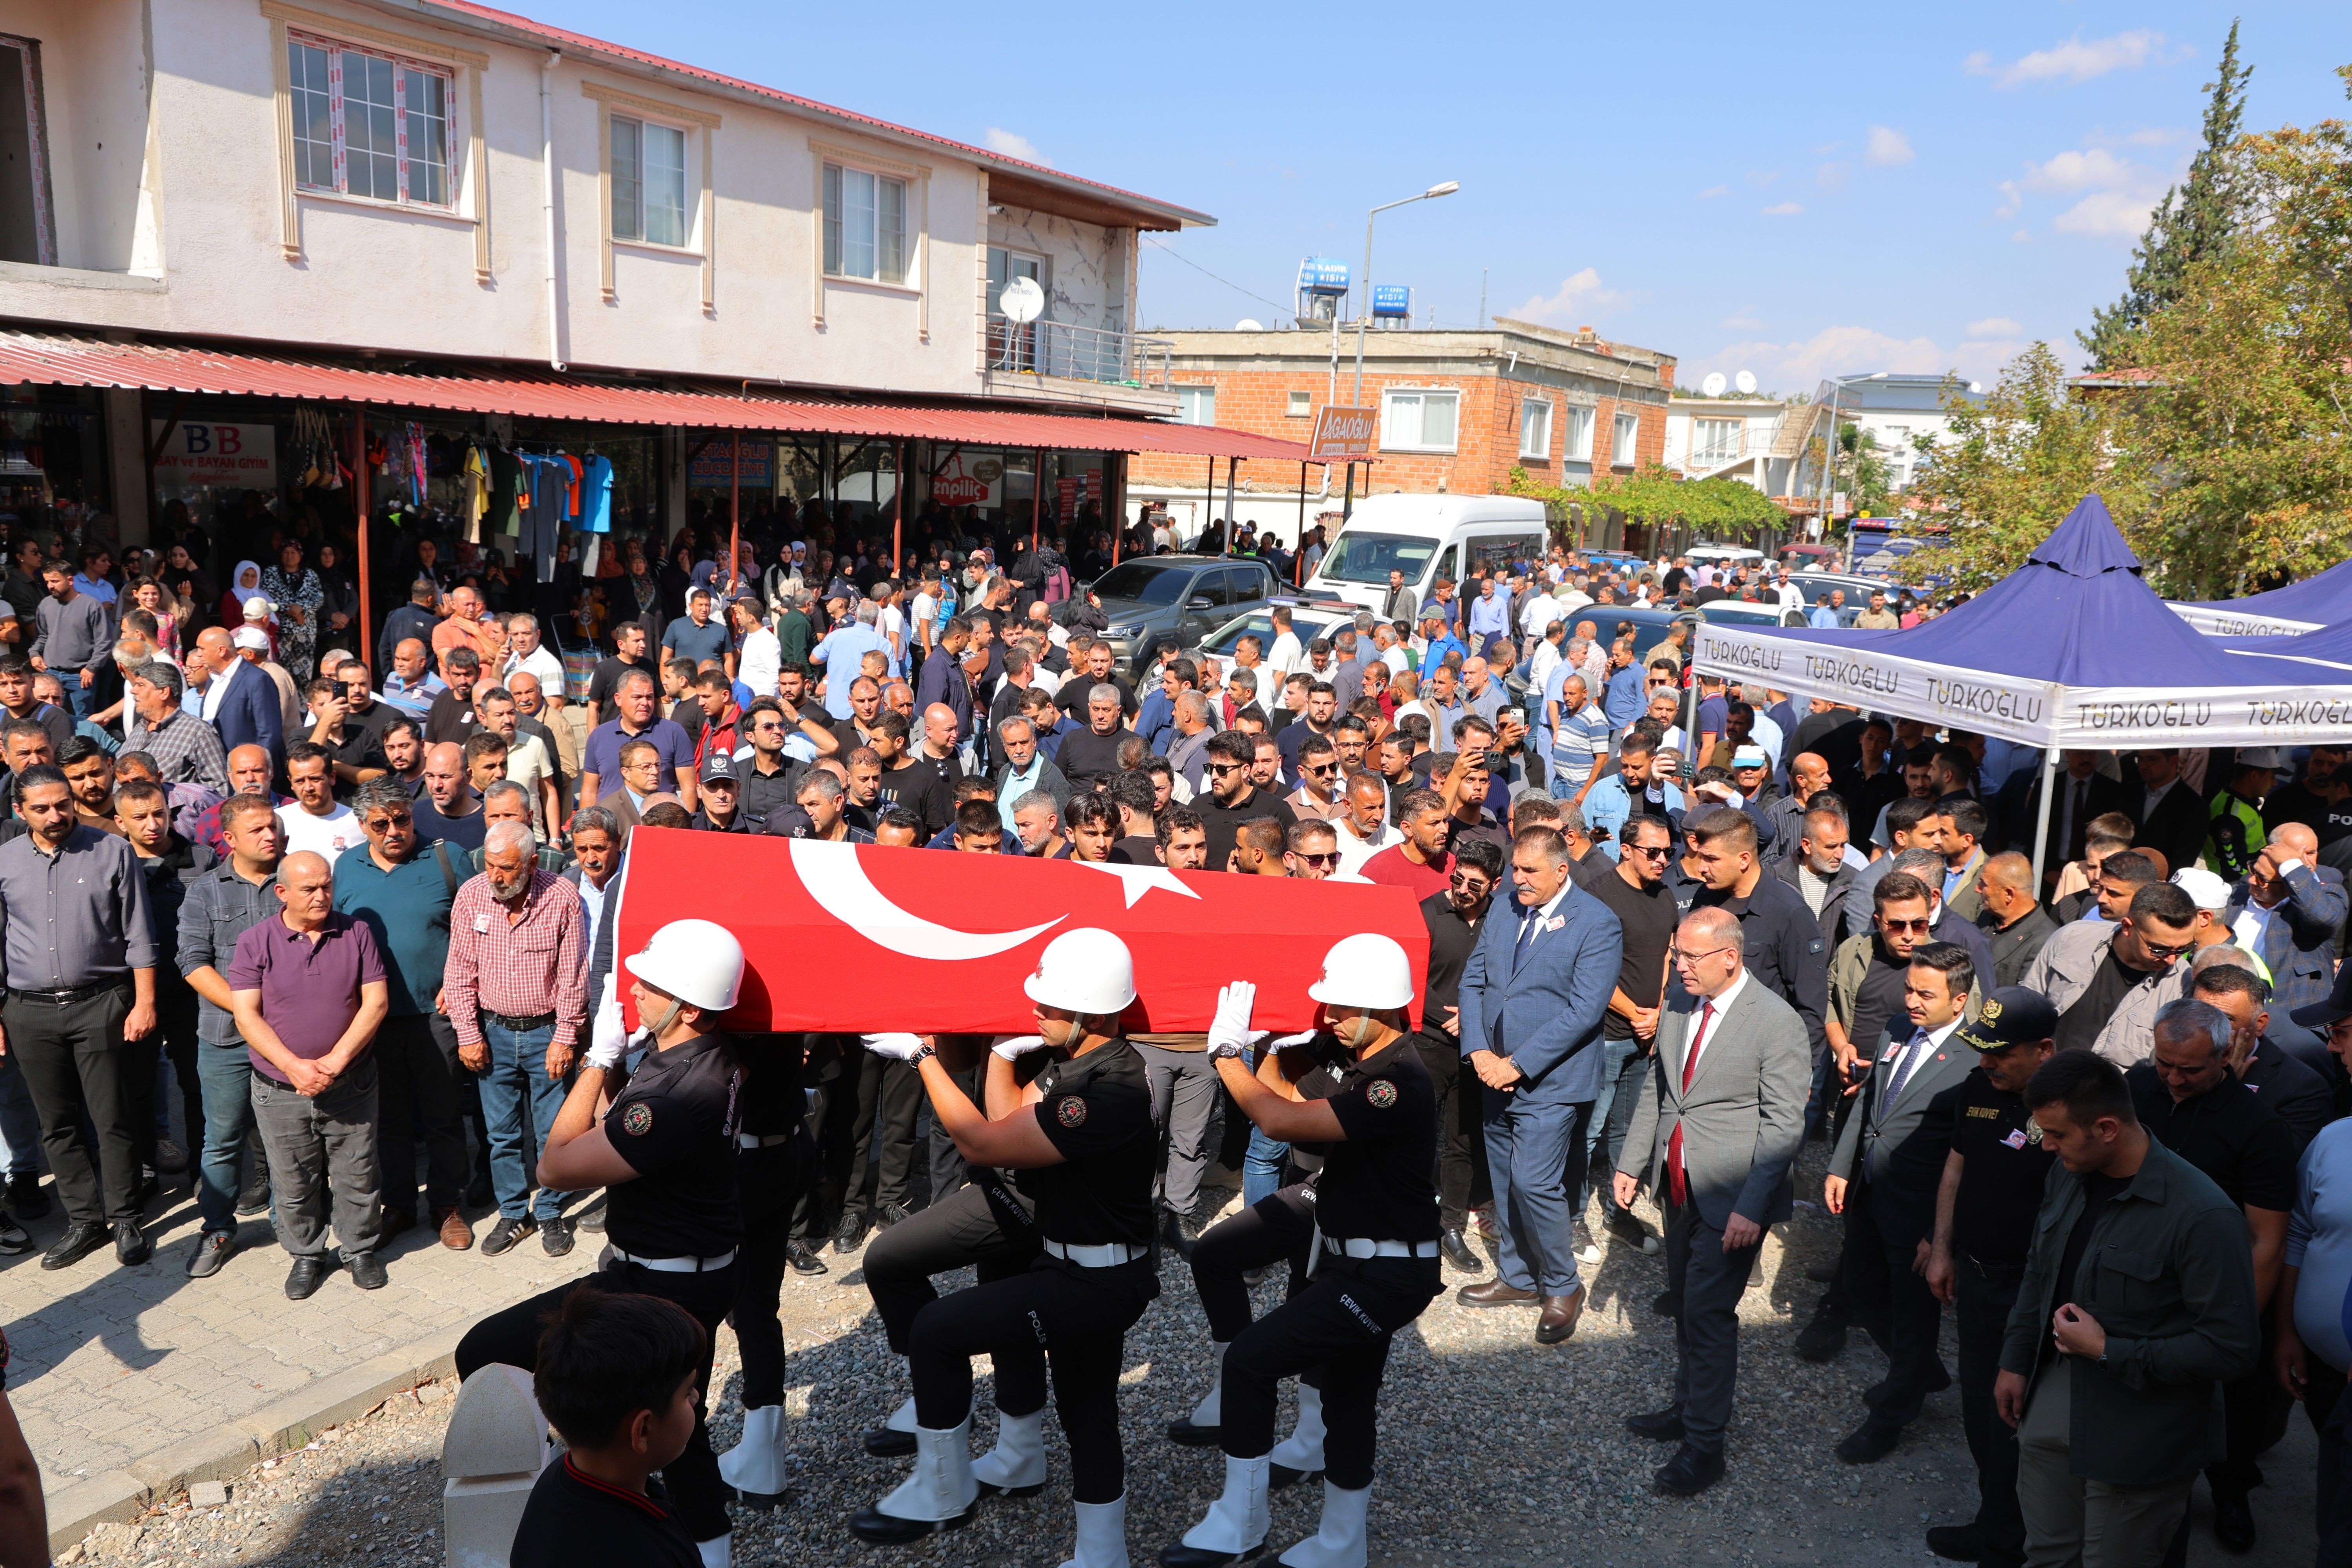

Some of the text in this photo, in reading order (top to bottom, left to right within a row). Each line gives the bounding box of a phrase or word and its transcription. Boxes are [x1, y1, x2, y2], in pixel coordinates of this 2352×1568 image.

[156, 455, 268, 469] BAY ve BAYAN GİYİM
[934, 480, 981, 501] enpiliç
[1301, 1189, 1316, 1203] ÇEVI
[1009, 1203, 1033, 1226] KUVVET
[1358, 1312, 1382, 1335] KUVVET
